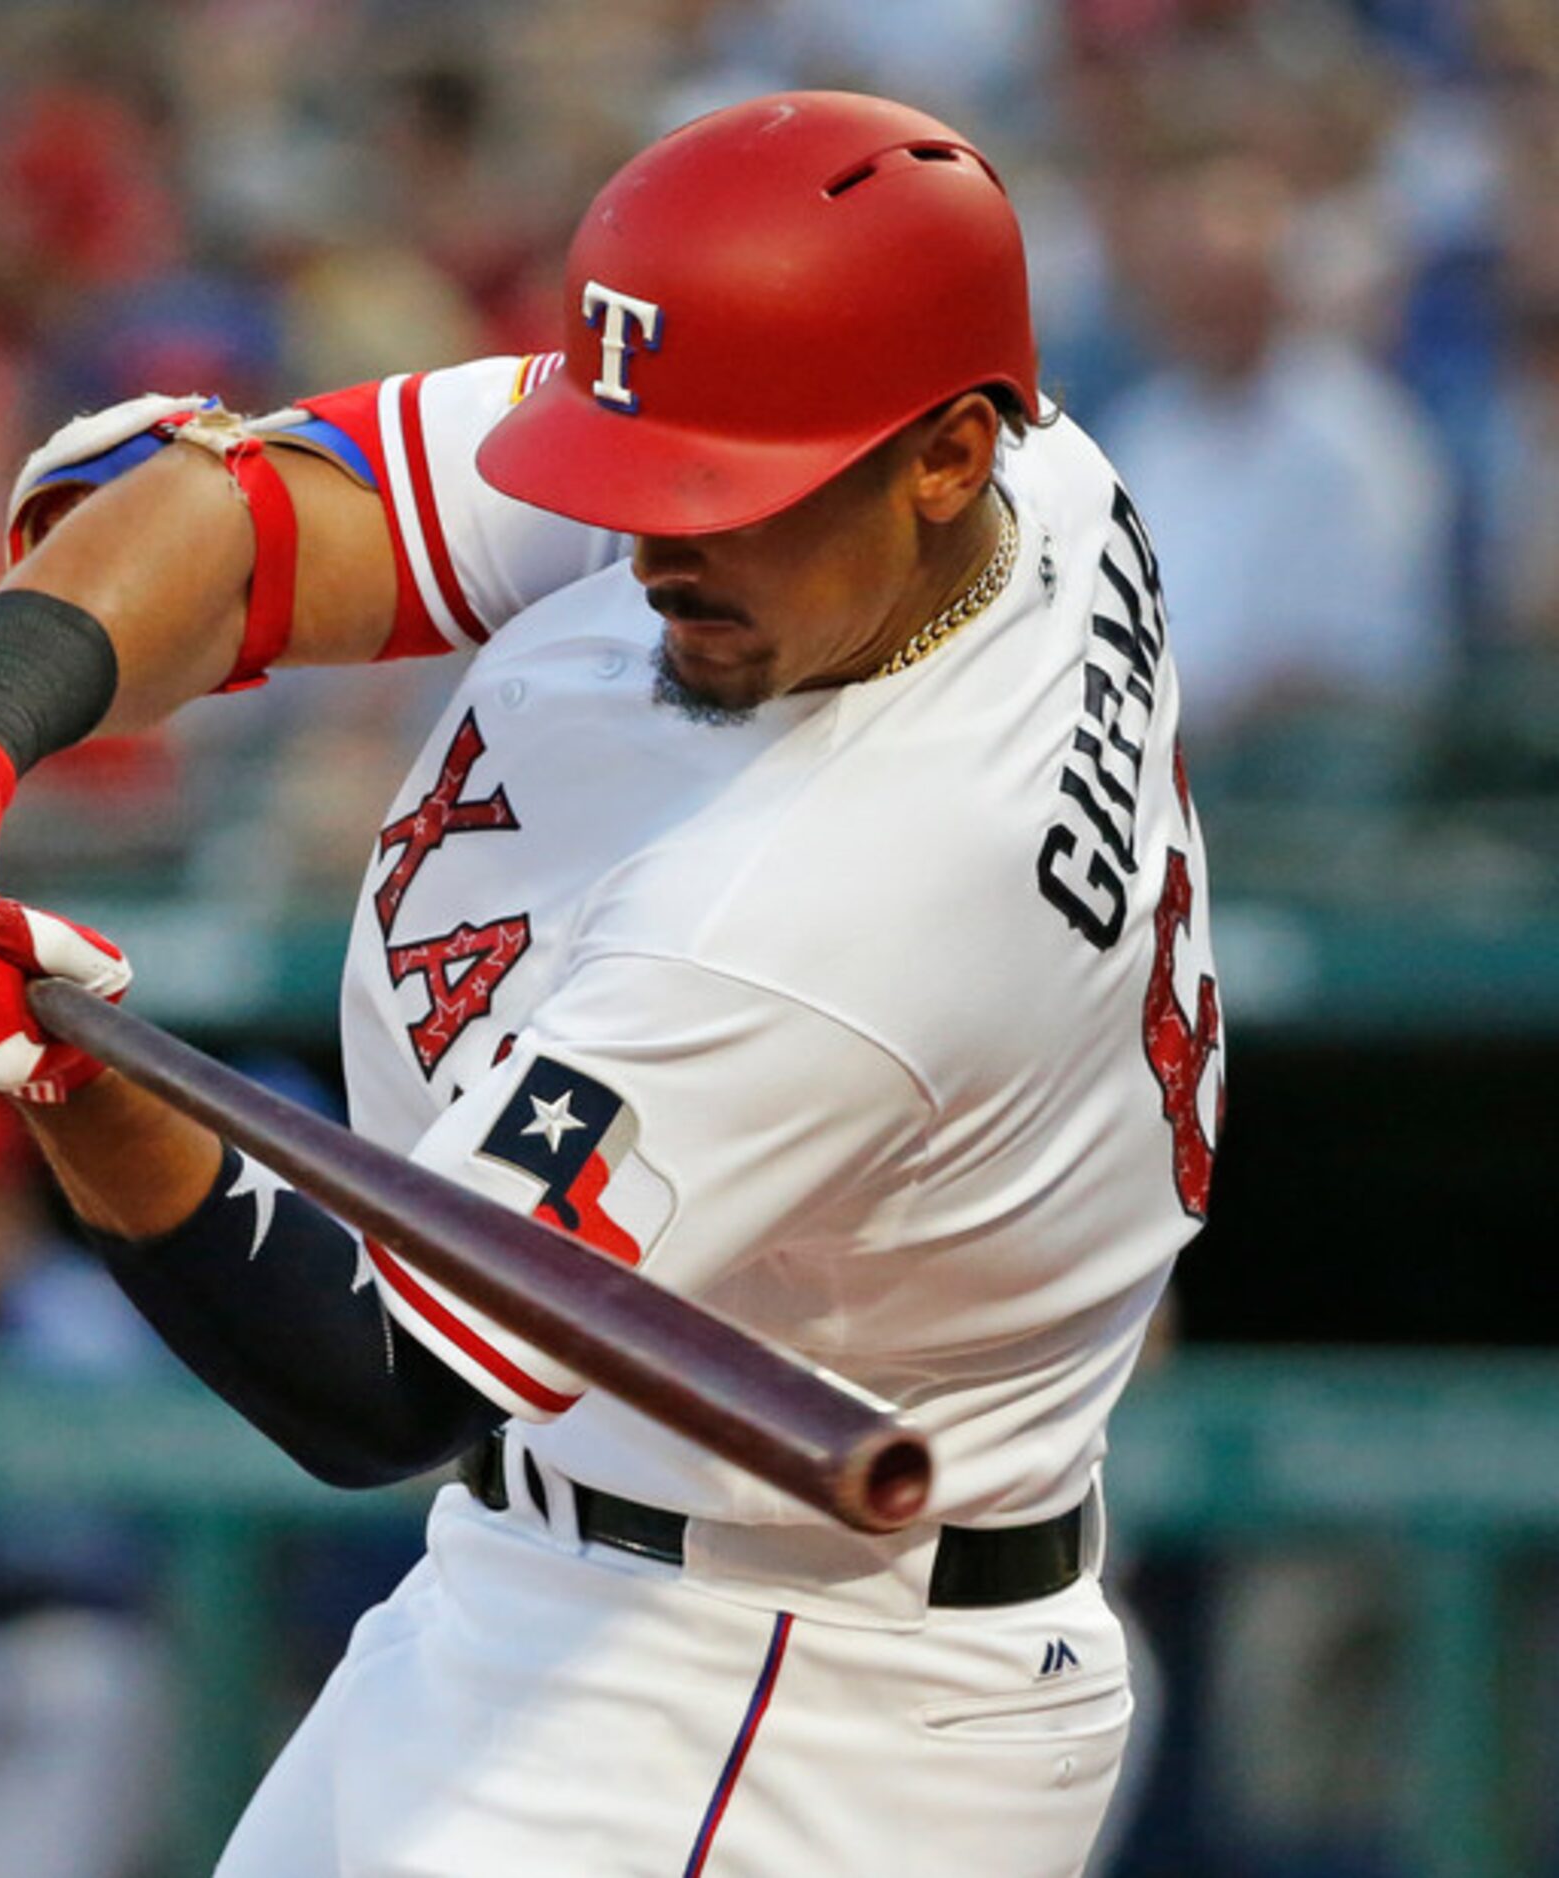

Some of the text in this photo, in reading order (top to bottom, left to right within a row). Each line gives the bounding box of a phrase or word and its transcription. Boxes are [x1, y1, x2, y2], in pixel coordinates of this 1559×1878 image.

[581, 279, 664, 418] T
[373, 705, 532, 1104] XA
[1141, 735, 1224, 1223] 6
